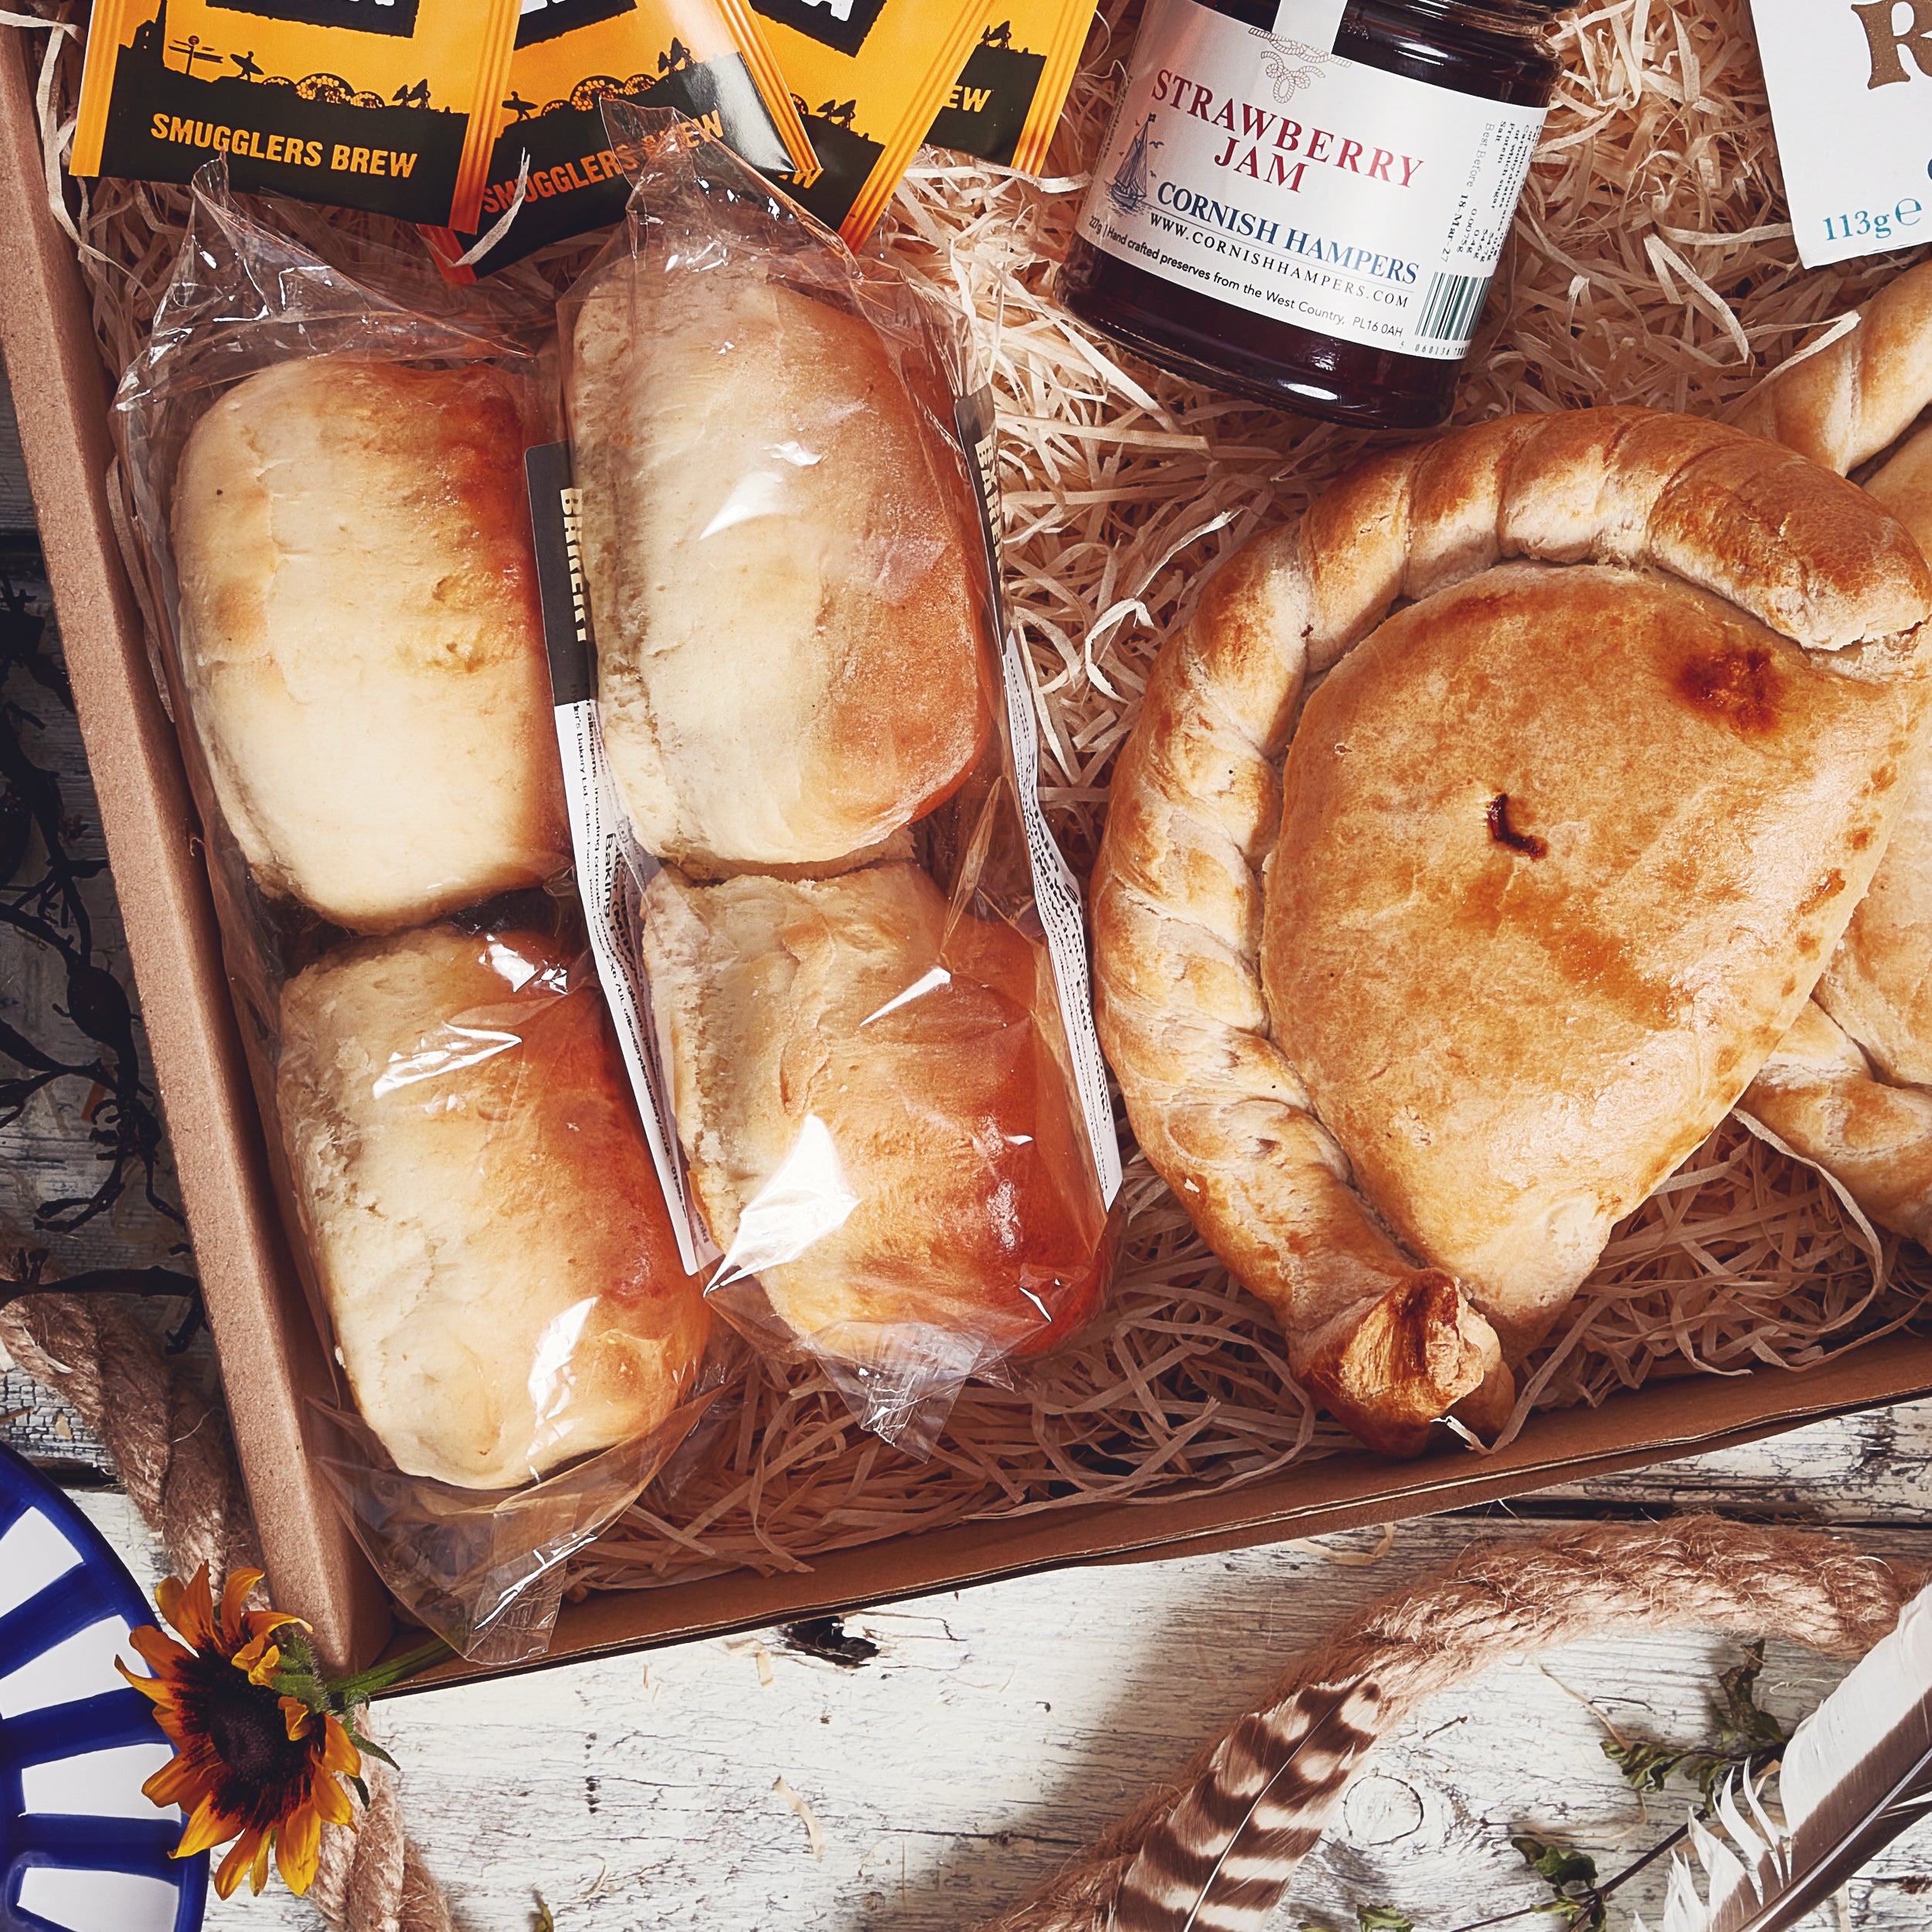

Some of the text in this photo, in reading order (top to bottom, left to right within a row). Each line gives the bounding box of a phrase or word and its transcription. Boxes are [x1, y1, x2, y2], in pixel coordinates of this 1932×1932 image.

[944, 84, 992, 113] EW
[1151, 69, 1424, 188] STRAWBERRY
[1495, 121, 1506, 142] Salt
[151, 113, 418, 178] SMUGGLERS BREW
[1214, 136, 1309, 193] JAM
[1497, 123, 1515, 164] Protein
[1158, 181, 1420, 285] CORNISH HAMPERS
[1440, 123, 1495, 262] Best Before 18-Mar-27
[1107, 226, 1128, 245] Hand
[1128, 239, 1161, 260] crafted
[1159, 253, 1211, 281] preserves
[1213, 272, 1240, 291] from
[1243, 283, 1262, 298] the
[1266, 290, 1295, 309] West
[1298, 301, 1345, 325] Country,
[1352, 315, 1379, 332] PL16
[1150, 213, 1409, 308] WWW.CORNISHHAMPERS.COM
[604, 832, 617, 918] Baking
